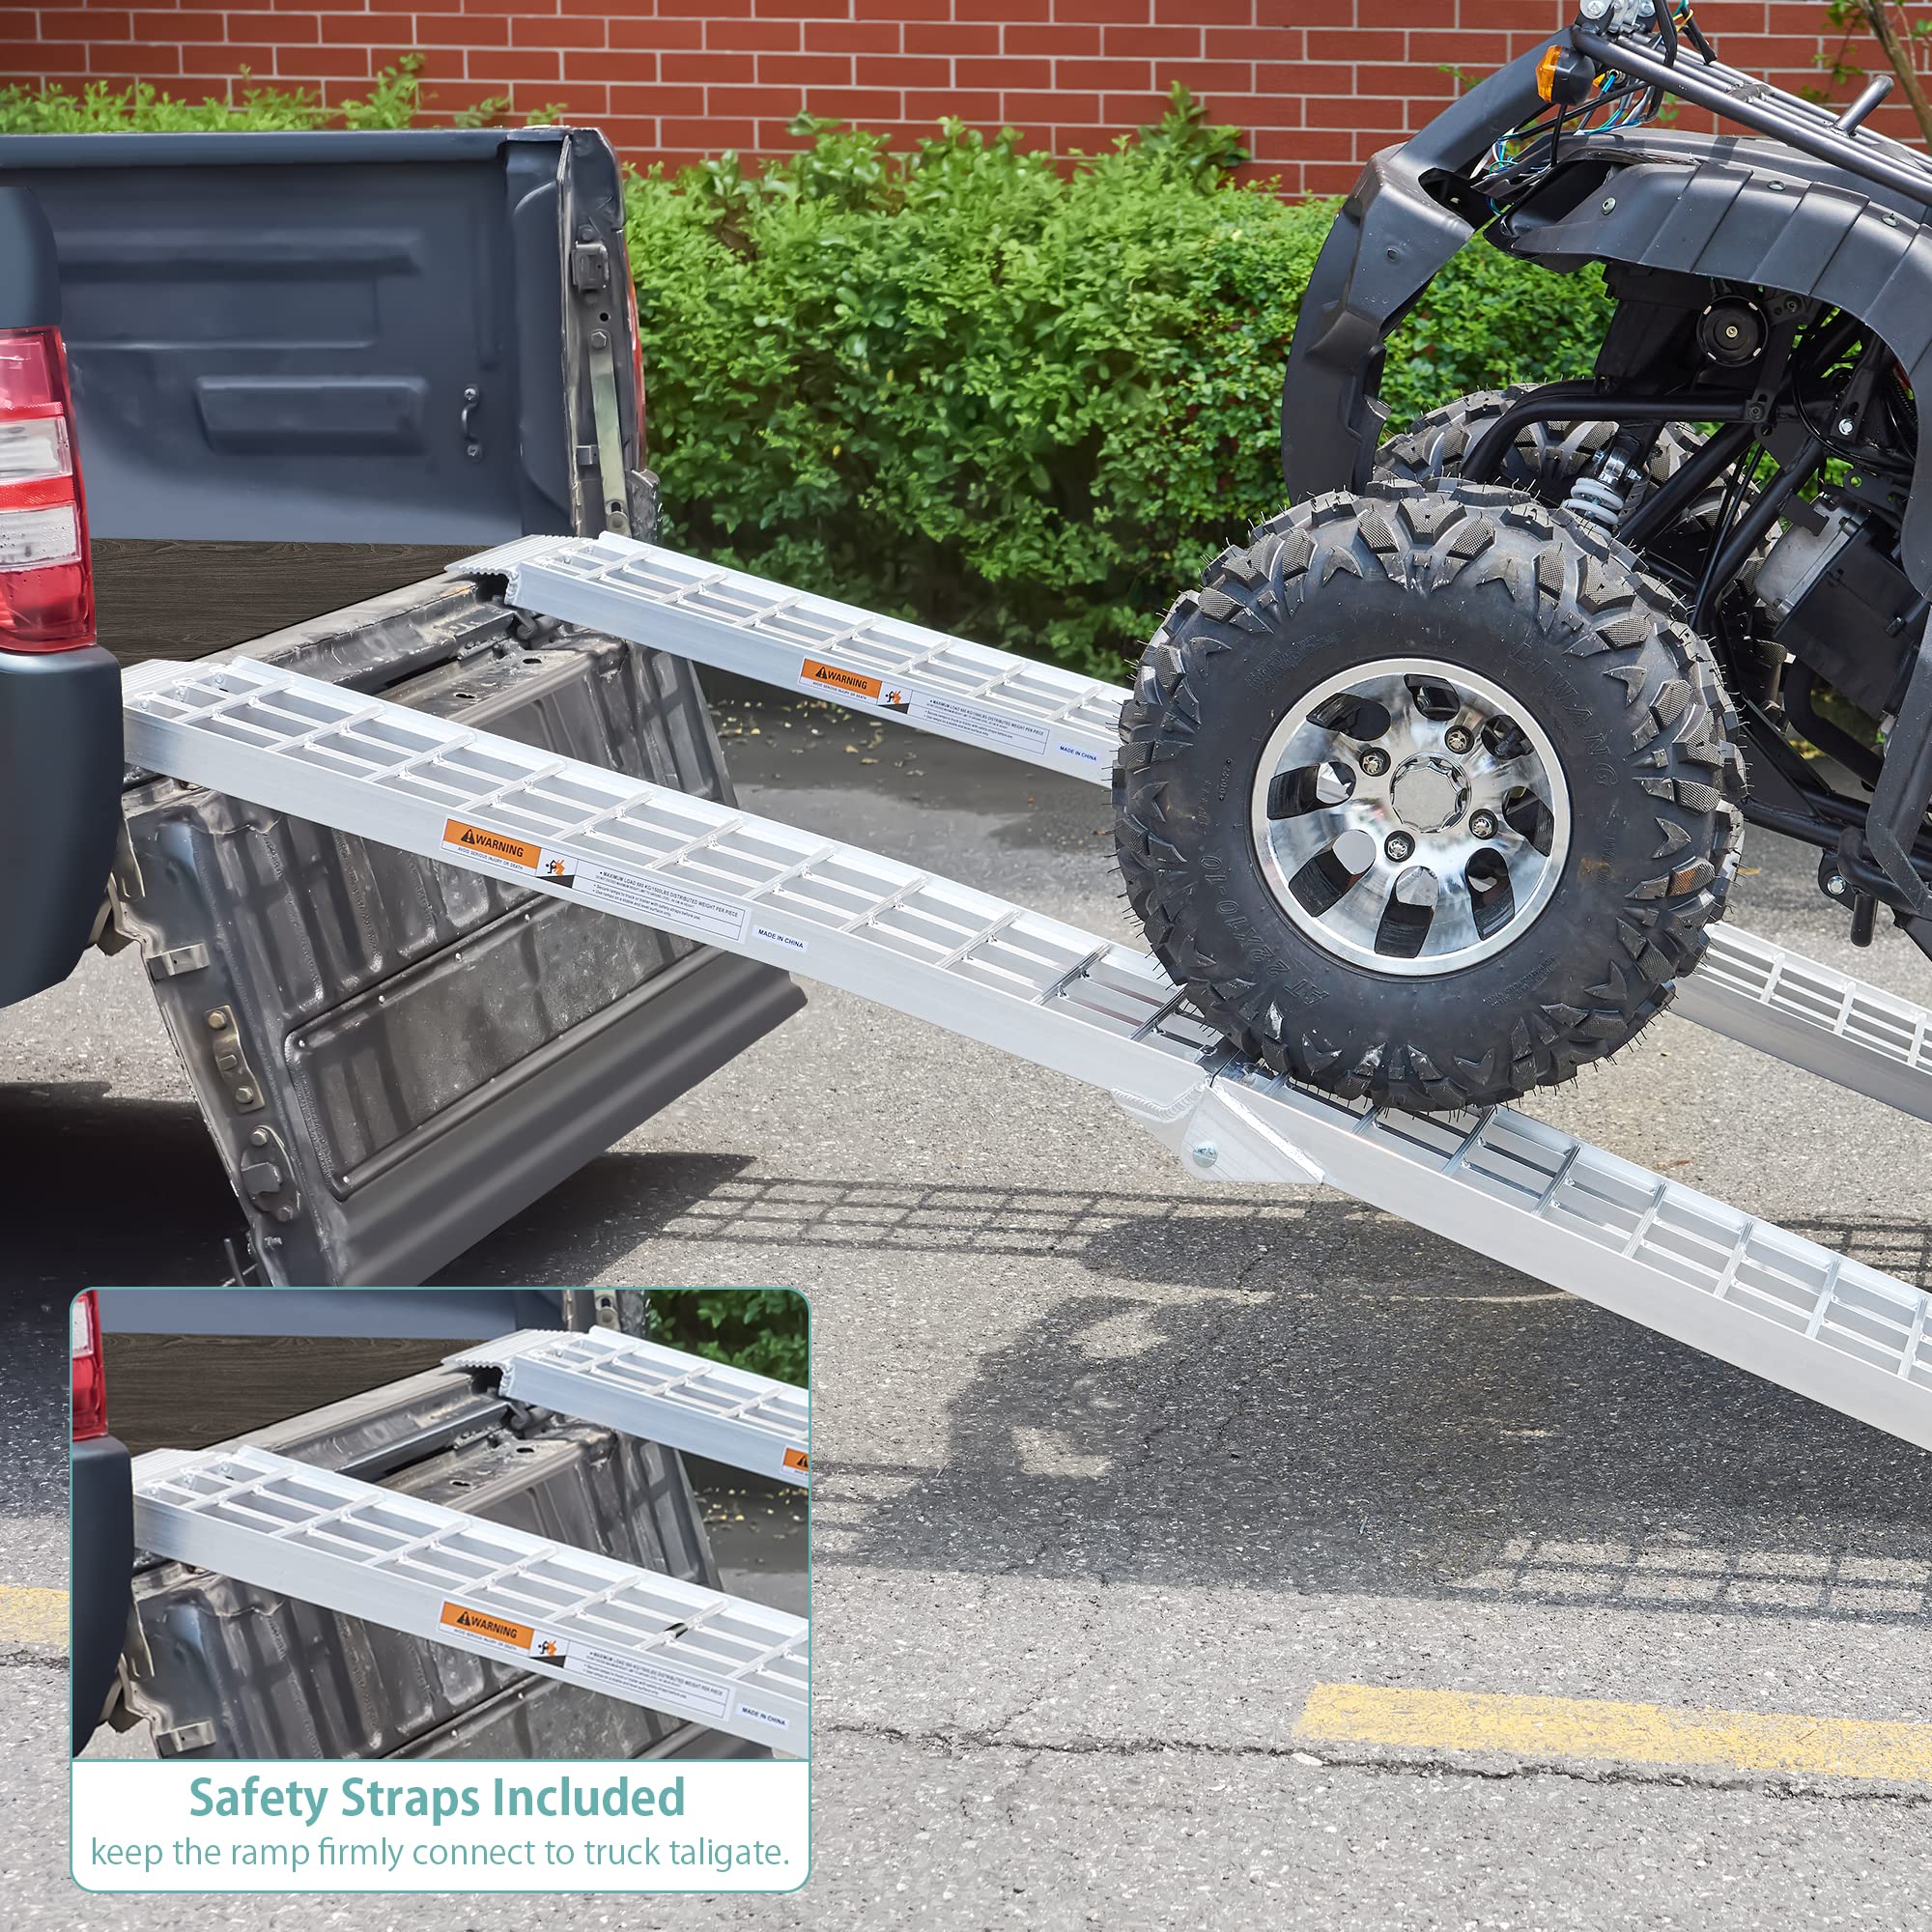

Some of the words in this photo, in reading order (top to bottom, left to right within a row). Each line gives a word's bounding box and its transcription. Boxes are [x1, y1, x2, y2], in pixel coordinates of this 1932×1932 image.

[827, 670, 867, 689] WARNING
[1509, 641, 1618, 786] LIWANG
[1082, 753, 1096, 761] CHINA
[475, 834, 524, 857] WARNING
[669, 892, 697, 904] DISTRIBUTED
[697, 900, 715, 910] WEIGHT
[1200, 855, 1291, 978] 22X10-10
[758, 929, 777, 940] MADE
[783, 938, 804, 949] CHINA
[1284, 979, 1330, 1006] AT
[470, 1615, 518, 1638] WARNING
[742, 1707, 758, 1718] MADE
[767, 1716, 785, 1725] CHINA
